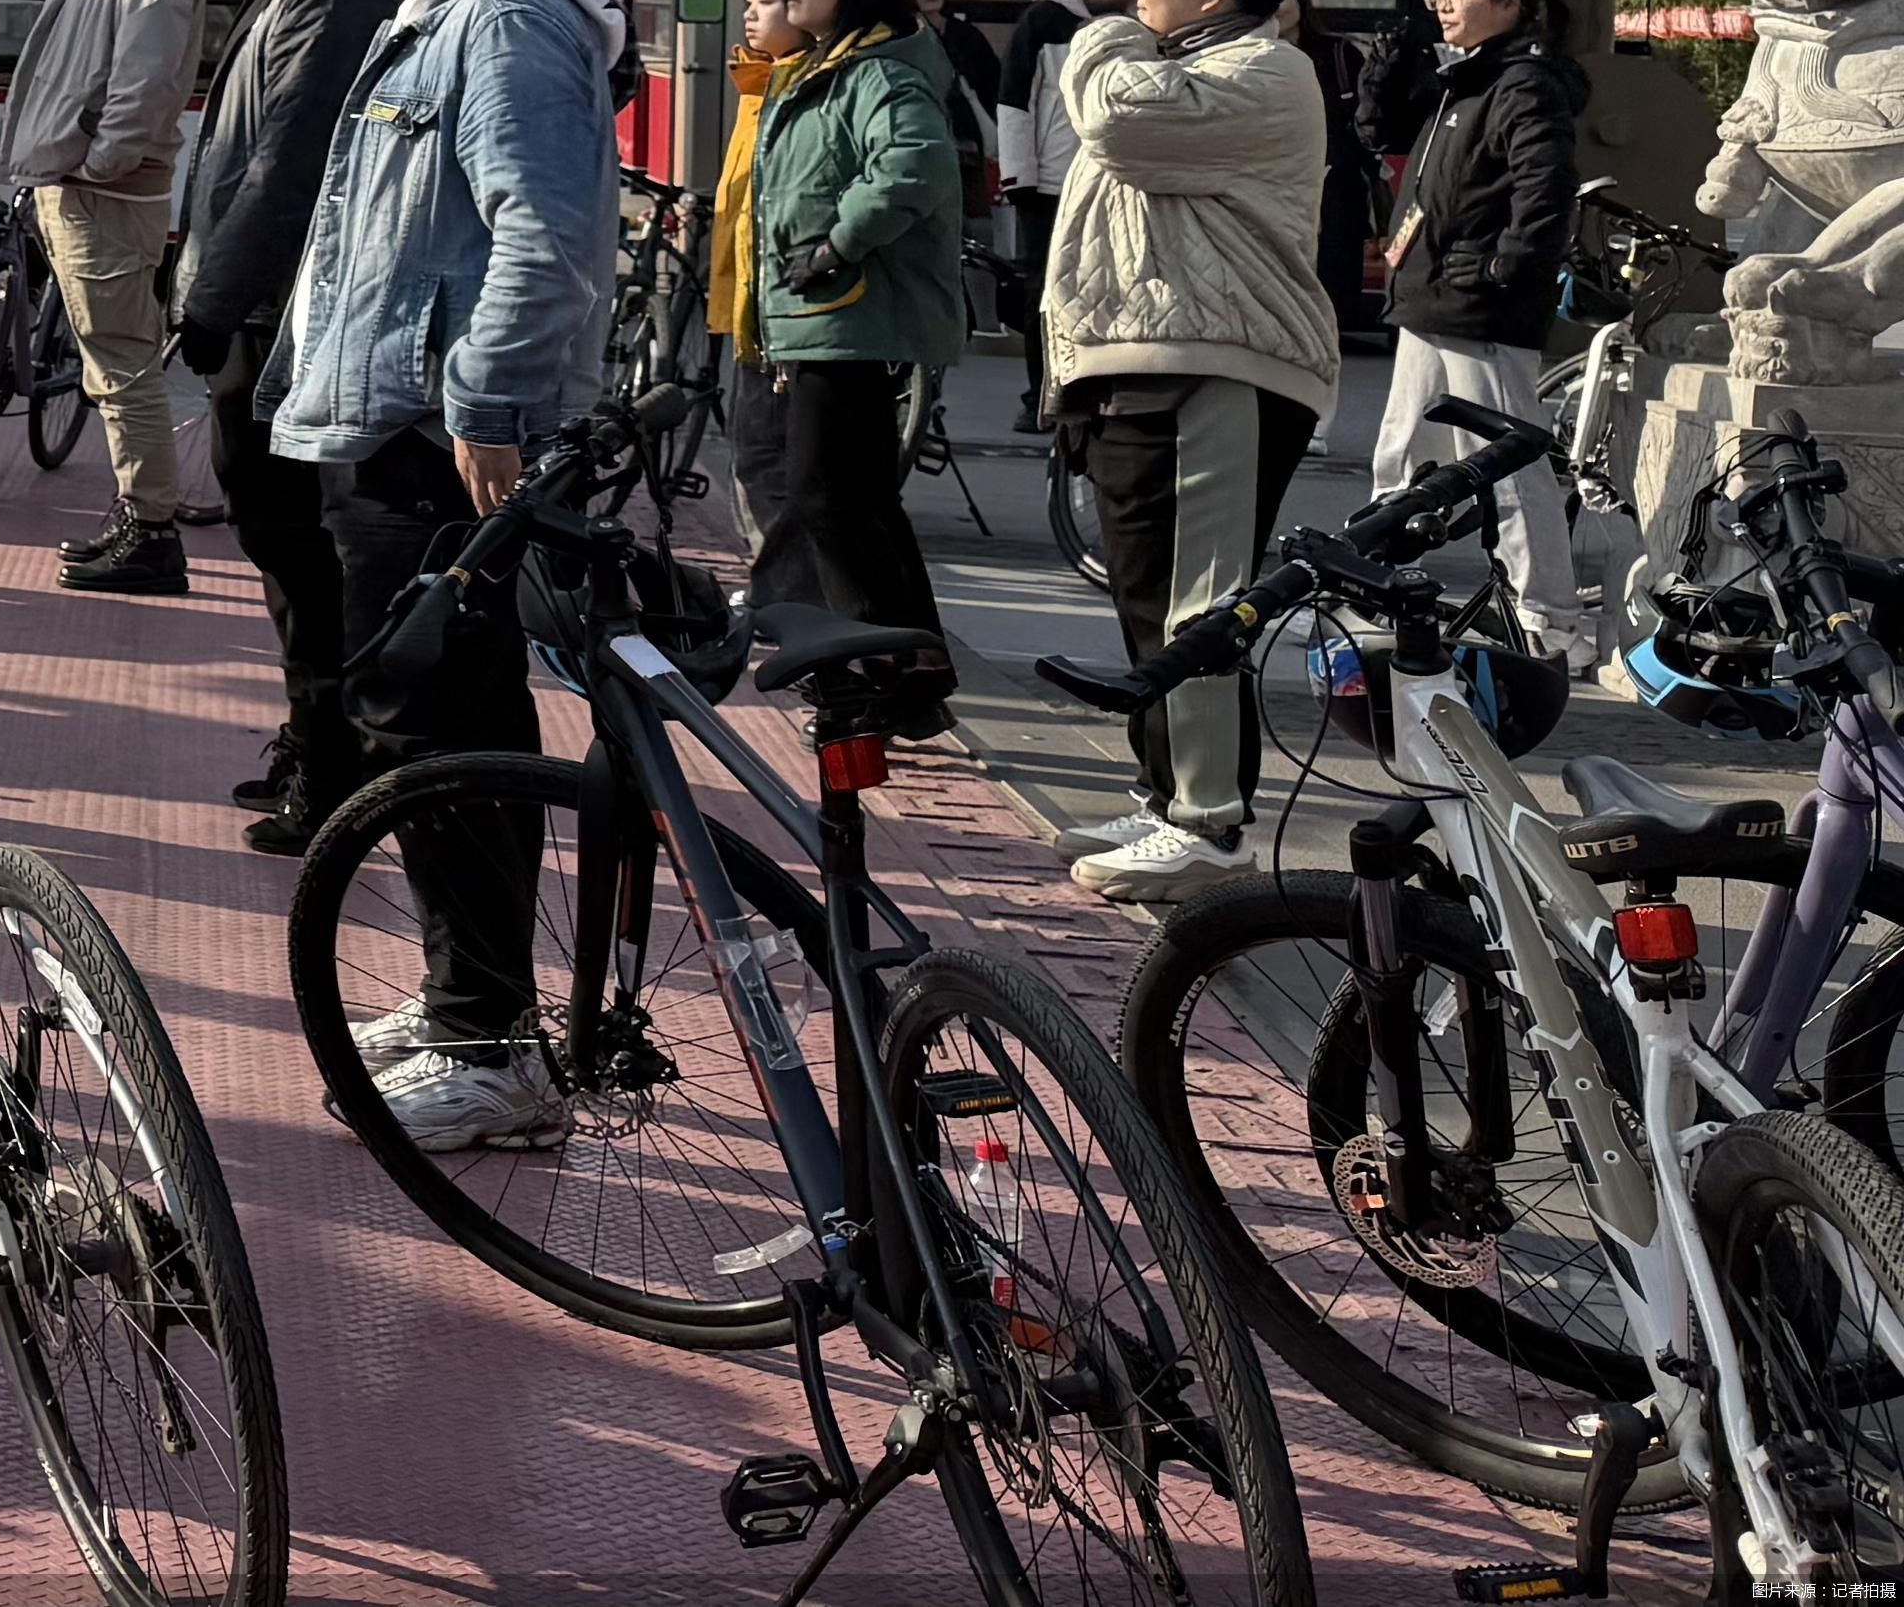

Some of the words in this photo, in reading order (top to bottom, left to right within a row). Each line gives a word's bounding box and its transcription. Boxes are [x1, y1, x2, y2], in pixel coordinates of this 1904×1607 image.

[1735, 821, 1786, 838] WT
[1563, 834, 1639, 859] WTB
[1169, 975, 1208, 1047] GIANT
